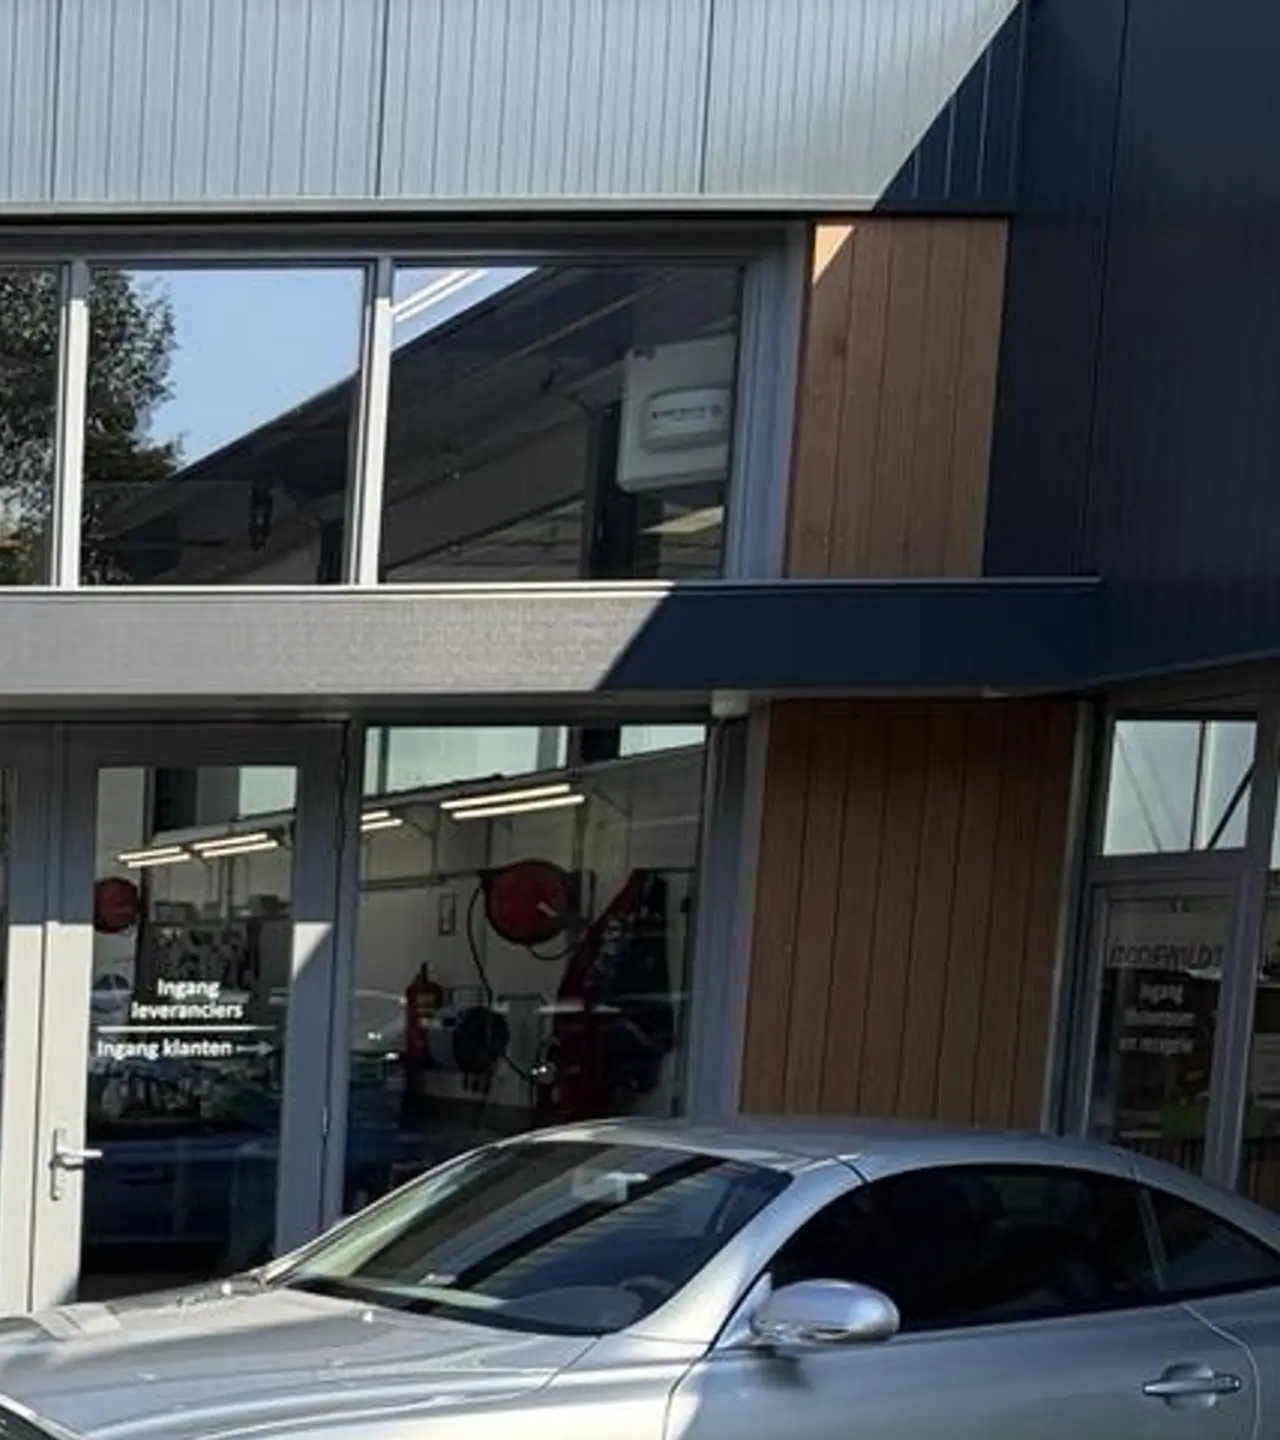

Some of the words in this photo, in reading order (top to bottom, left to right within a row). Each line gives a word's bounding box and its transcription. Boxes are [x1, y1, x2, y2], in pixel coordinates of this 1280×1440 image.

[157, 977, 221, 1000] Ingang
[130, 1001, 243, 1020] leveranciers
[96, 1038, 159, 1060] Ingang
[162, 1037, 233, 1057] klanten
